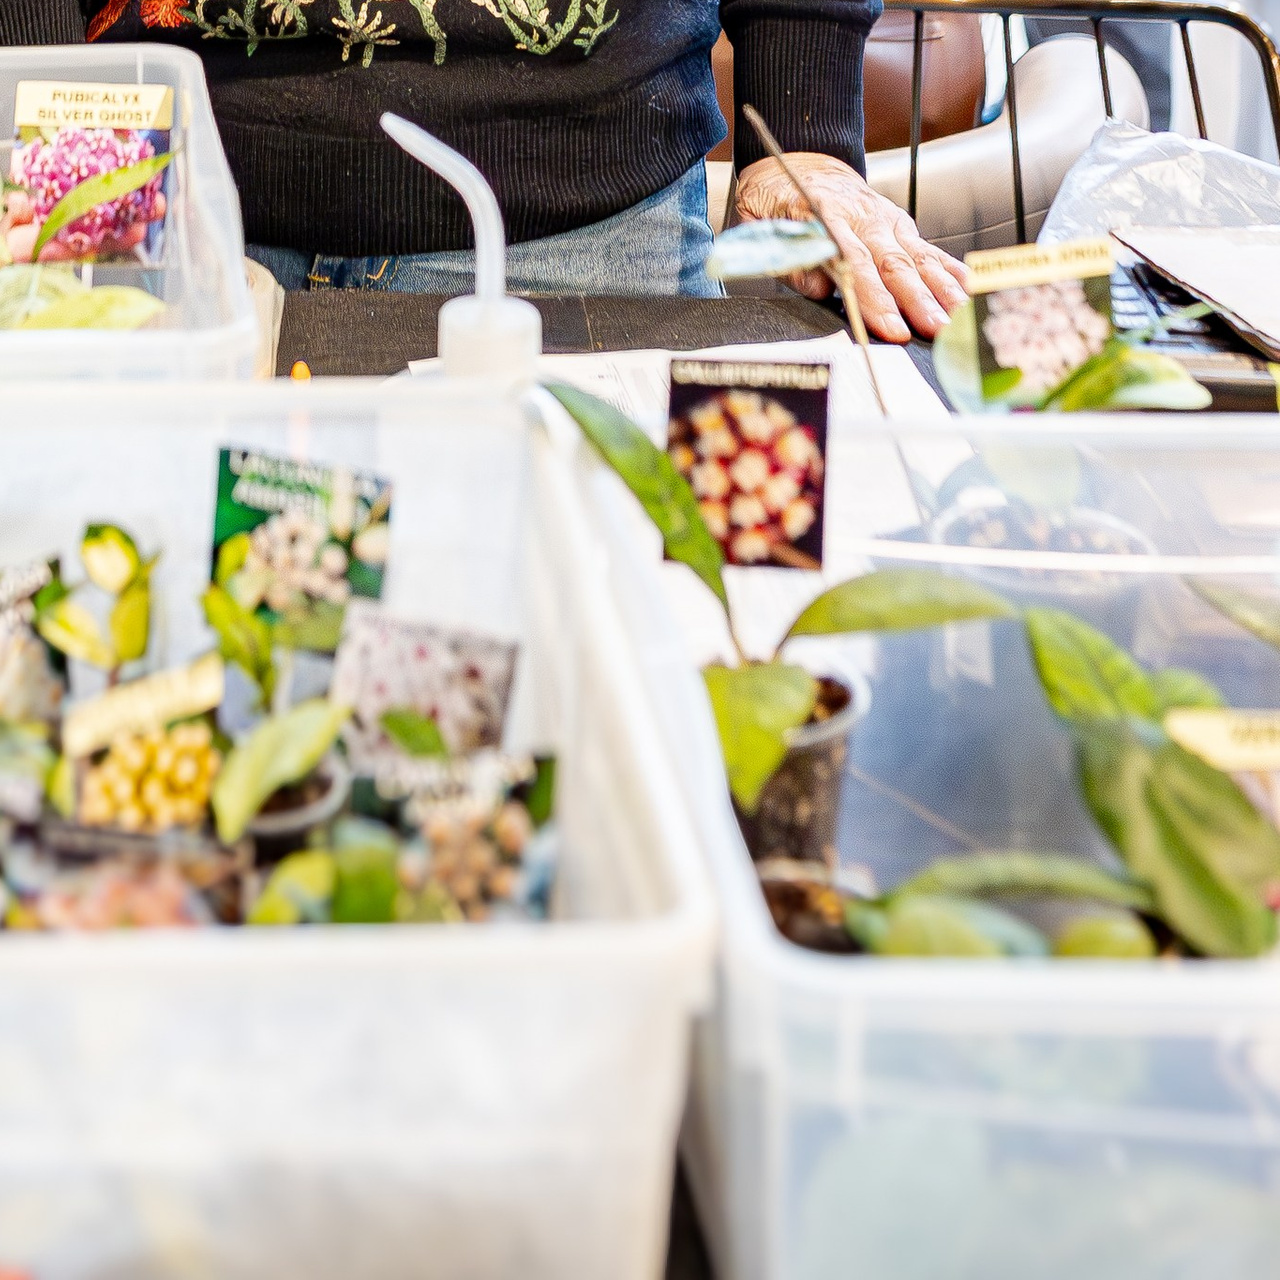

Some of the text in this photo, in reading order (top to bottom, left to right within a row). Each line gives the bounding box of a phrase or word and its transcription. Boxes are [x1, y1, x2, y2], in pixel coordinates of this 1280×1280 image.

[51, 89, 141, 105] PUBICALYX
[37, 107, 153, 123] SILVER GHOST
